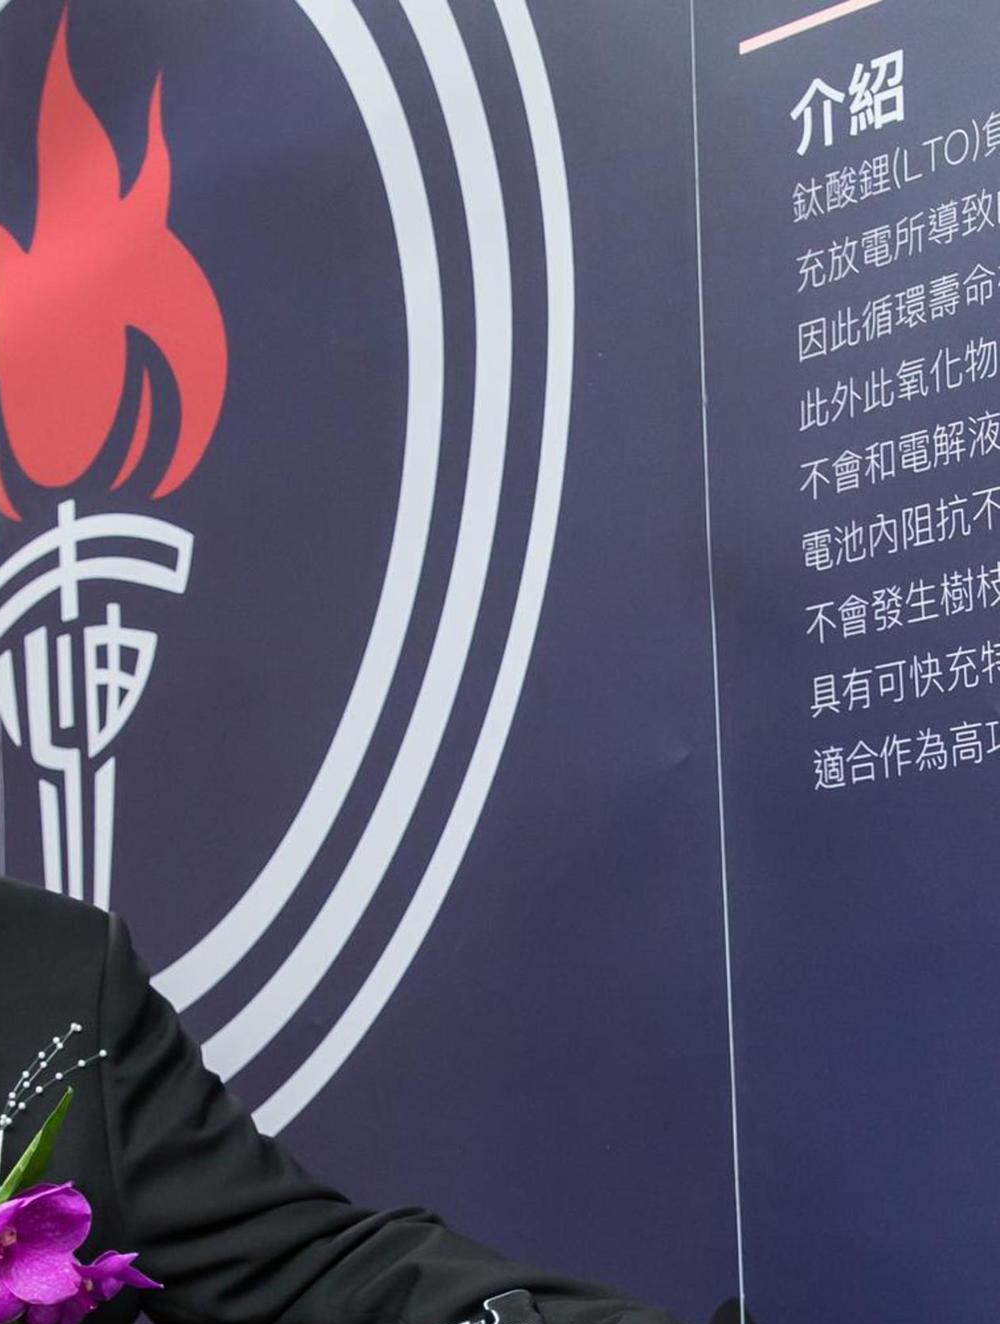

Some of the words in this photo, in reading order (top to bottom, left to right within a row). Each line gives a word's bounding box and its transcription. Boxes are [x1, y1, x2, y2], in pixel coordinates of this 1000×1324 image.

[790, 49, 905, 156] 介紹
[796, 188, 1000, 293] 充放電所導致
[798, 263, 1000, 362] 因此循環壽命
[800, 337, 998, 432] 此外此氧化物
[800, 410, 1000, 500] 不會和電解液
[805, 561, 1000, 644] 不會發生樹枝
